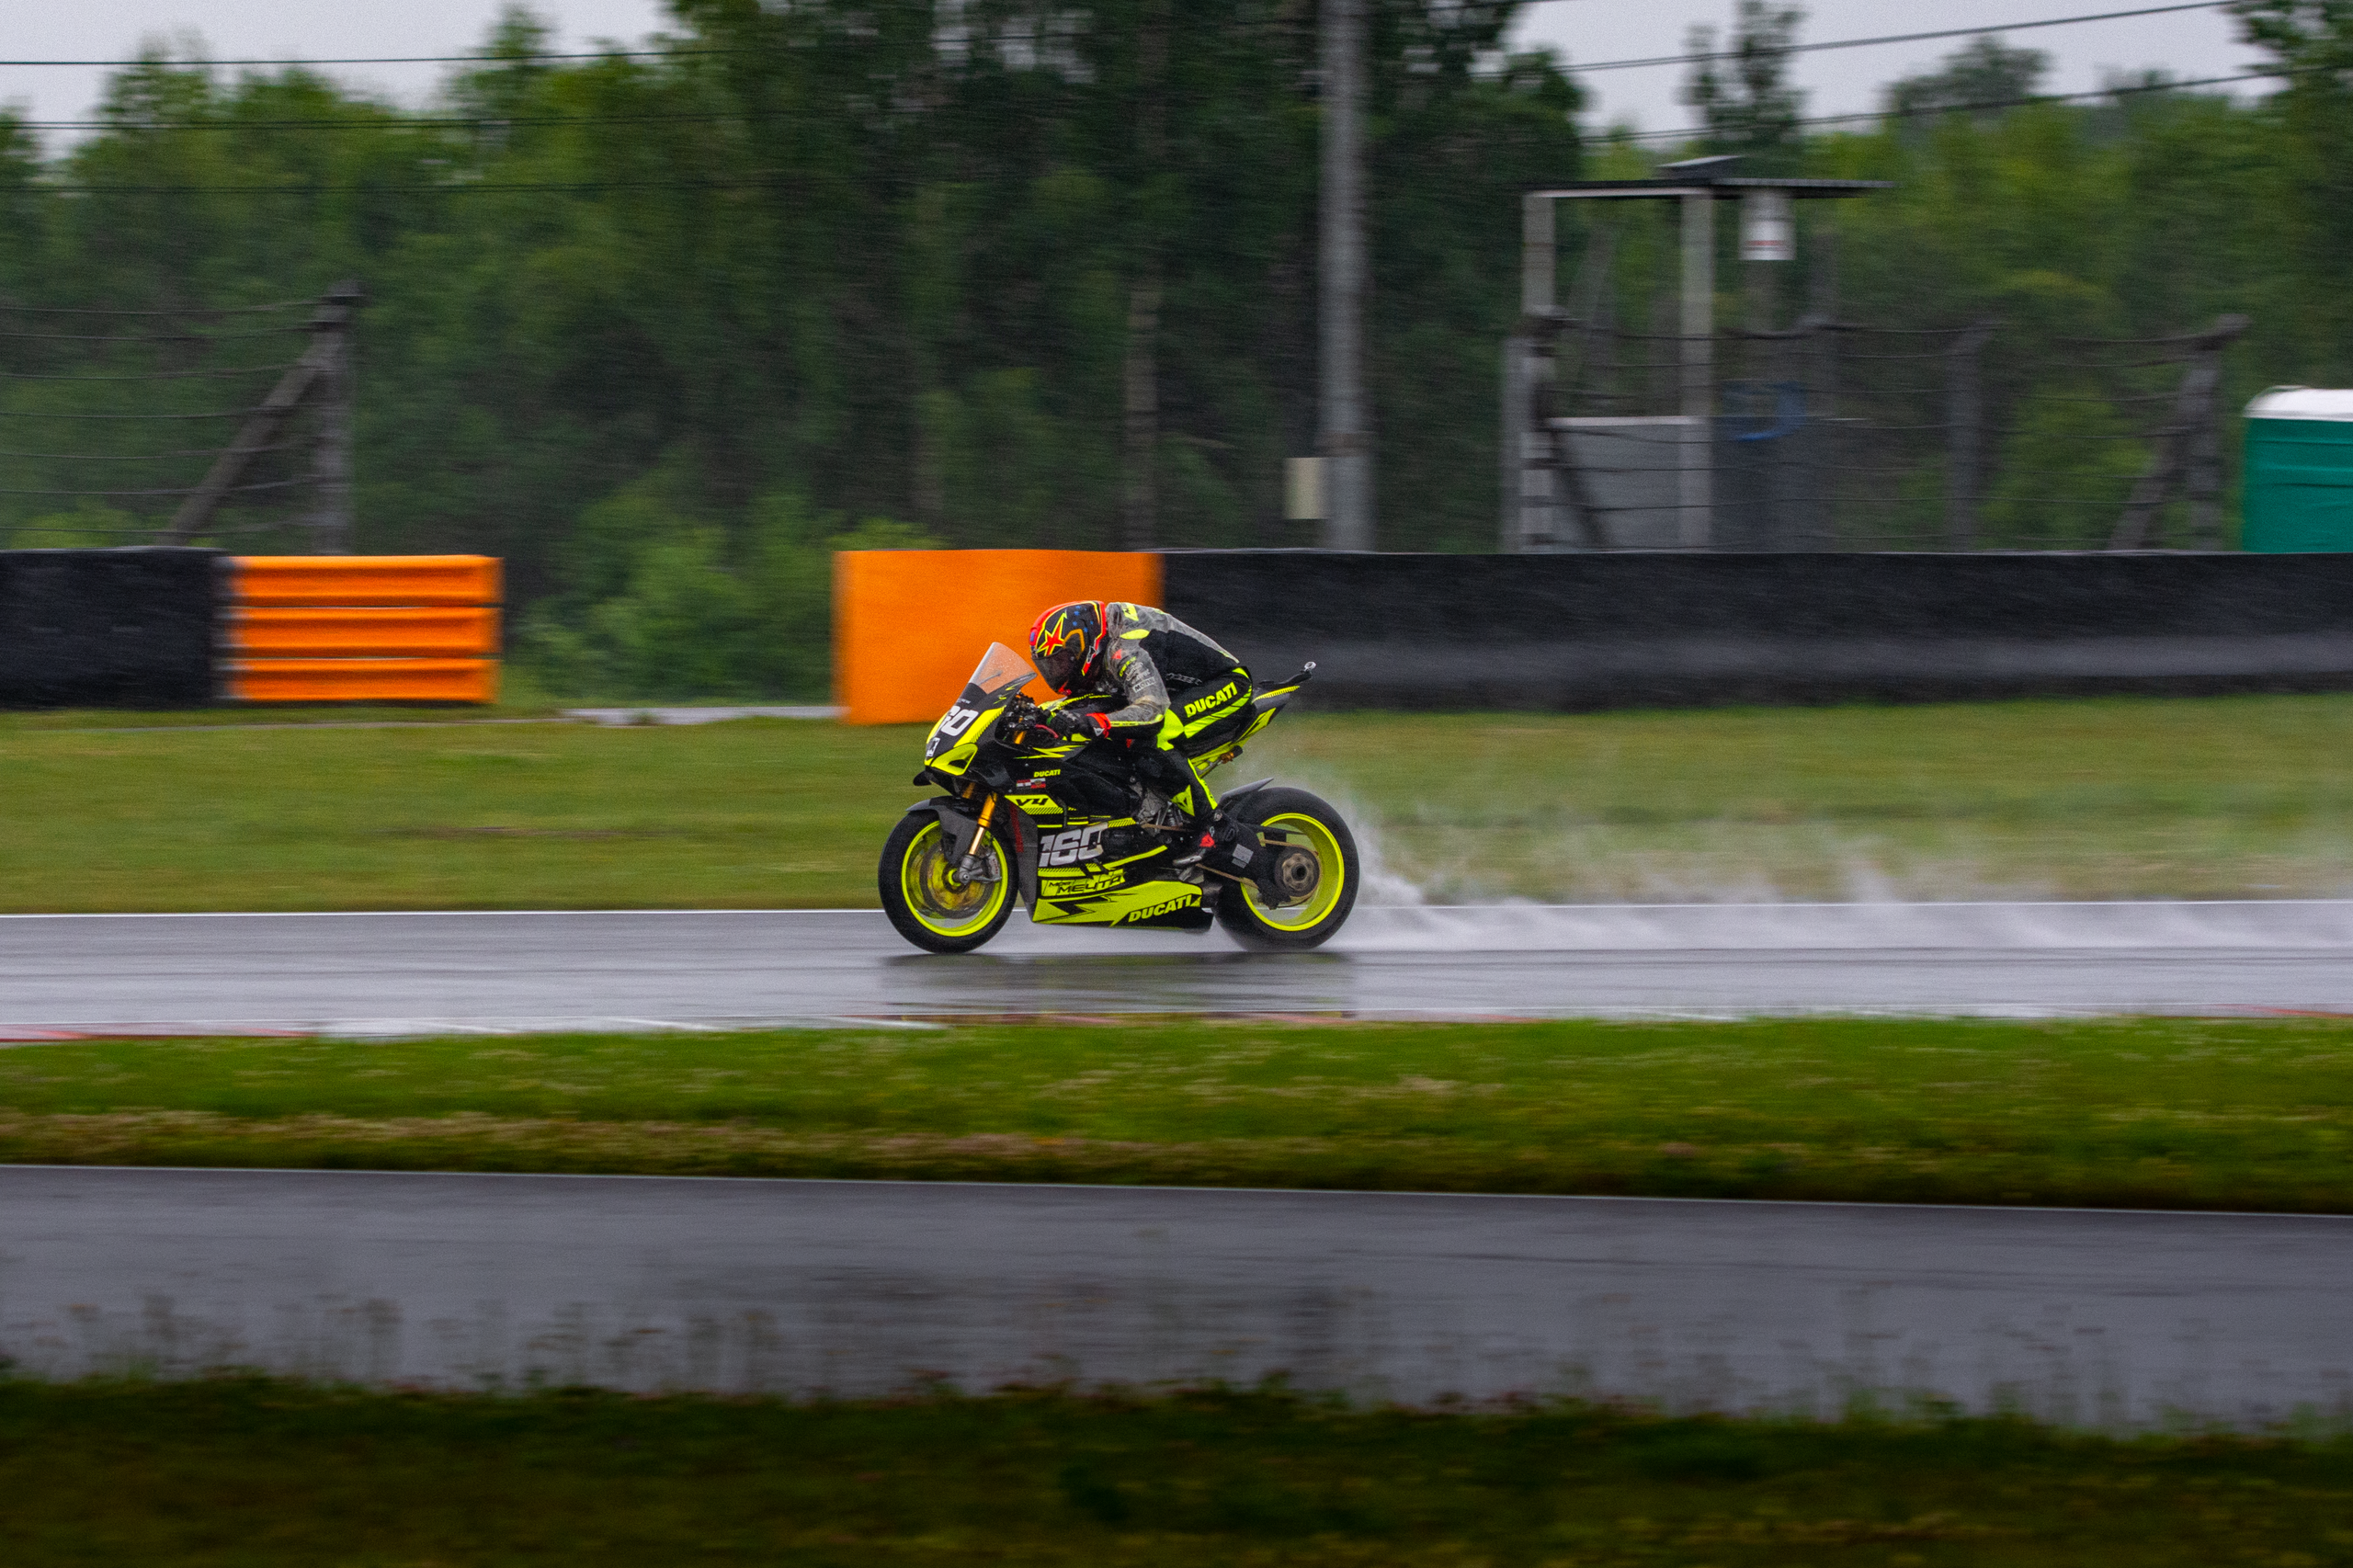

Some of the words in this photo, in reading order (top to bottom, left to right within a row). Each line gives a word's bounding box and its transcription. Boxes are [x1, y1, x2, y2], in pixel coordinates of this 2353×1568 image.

[1183, 681, 1238, 718] DUCATI
[1033, 768, 1061, 778] DUCATI
[1016, 798, 1049, 806] V4
[1038, 822, 1108, 868] 160
[1128, 893, 1192, 923] DUCATI
